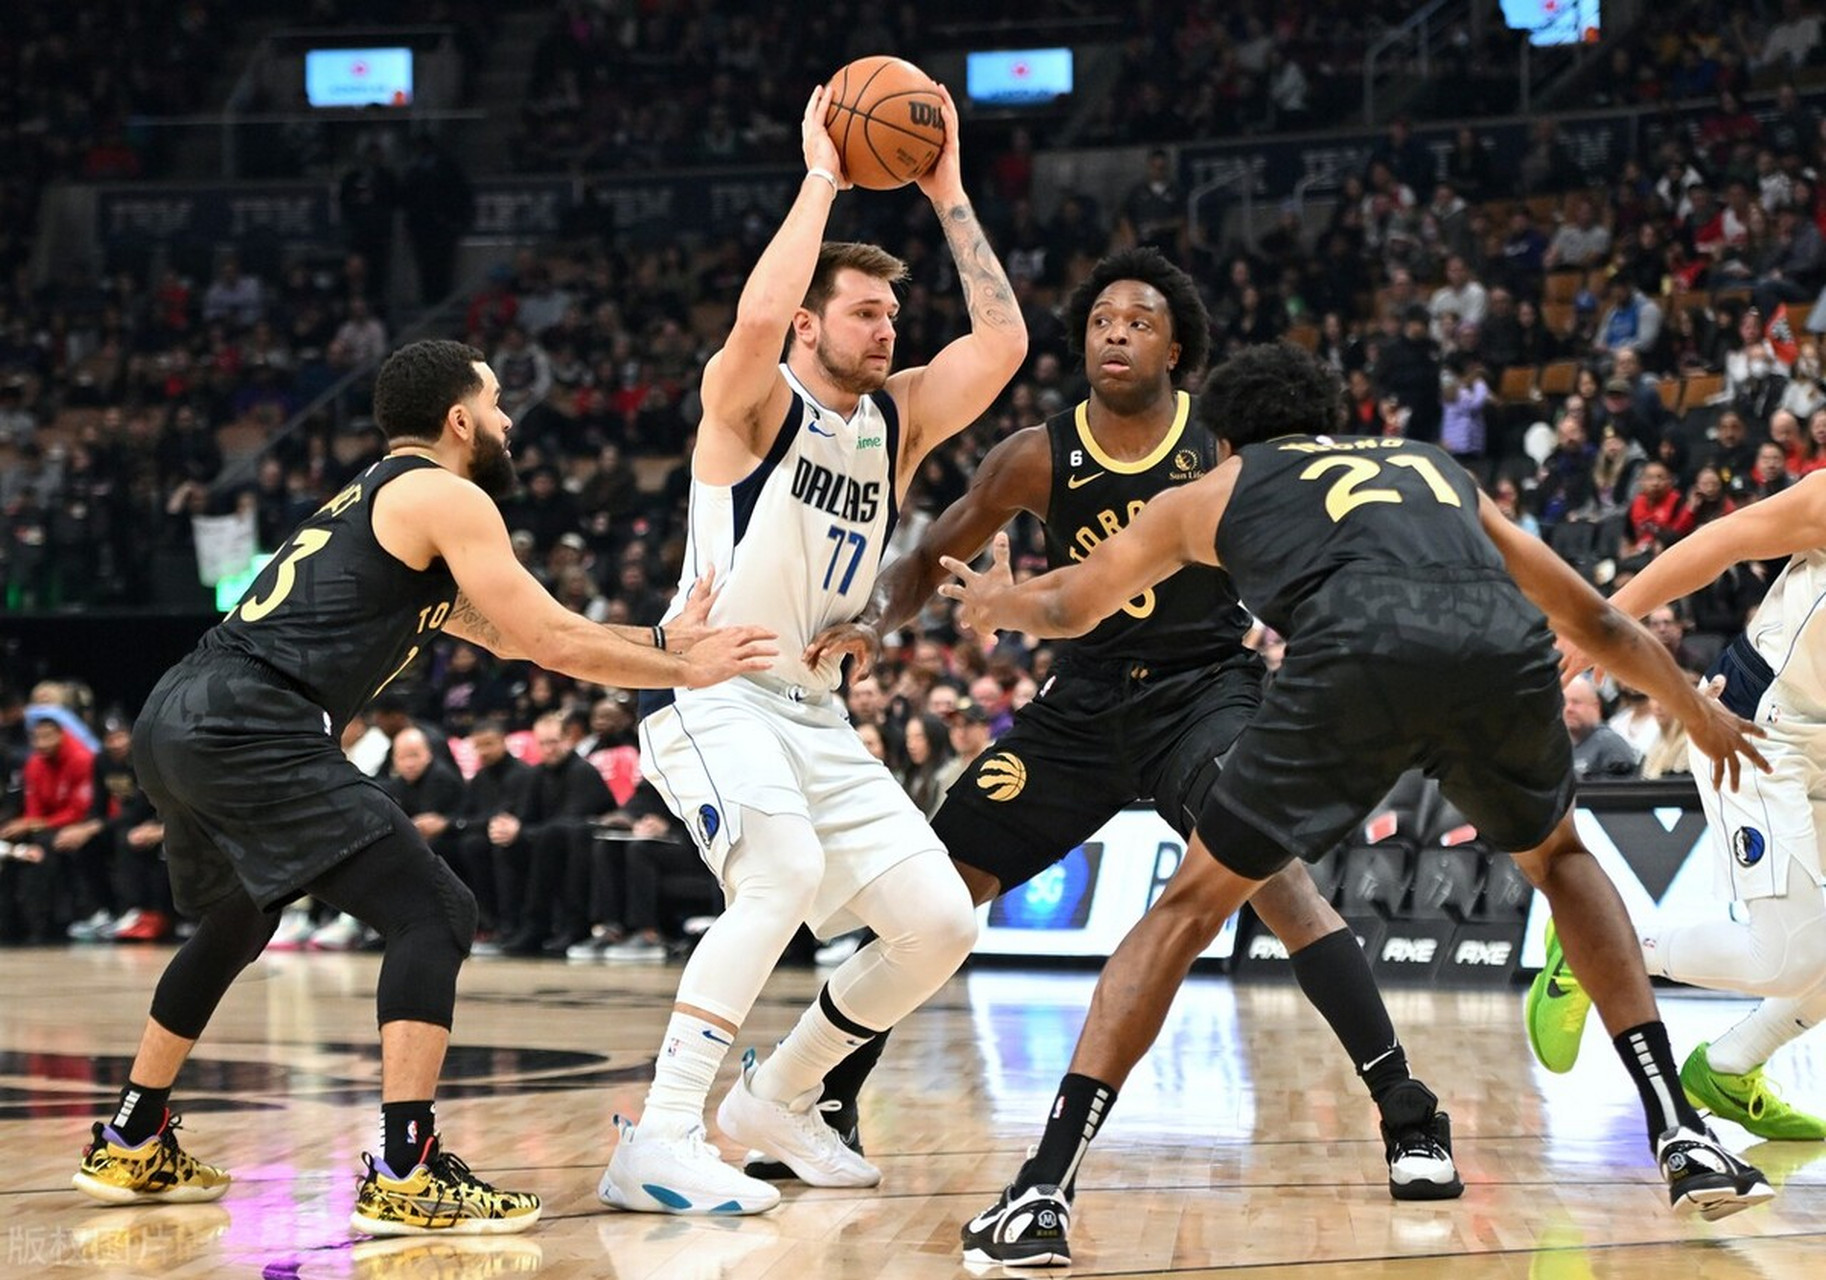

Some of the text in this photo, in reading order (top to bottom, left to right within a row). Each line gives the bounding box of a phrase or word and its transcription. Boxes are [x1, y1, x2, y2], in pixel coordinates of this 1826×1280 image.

[1070, 450, 1083, 467] 6
[1169, 471, 1187, 480] Sun
[791, 455, 880, 523] DALAS
[1299, 455, 1462, 523] 21
[223, 528, 332, 623] 3
[823, 524, 867, 596] 77
[1382, 937, 1438, 963] AXE
[1455, 939, 1513, 966] AXE
